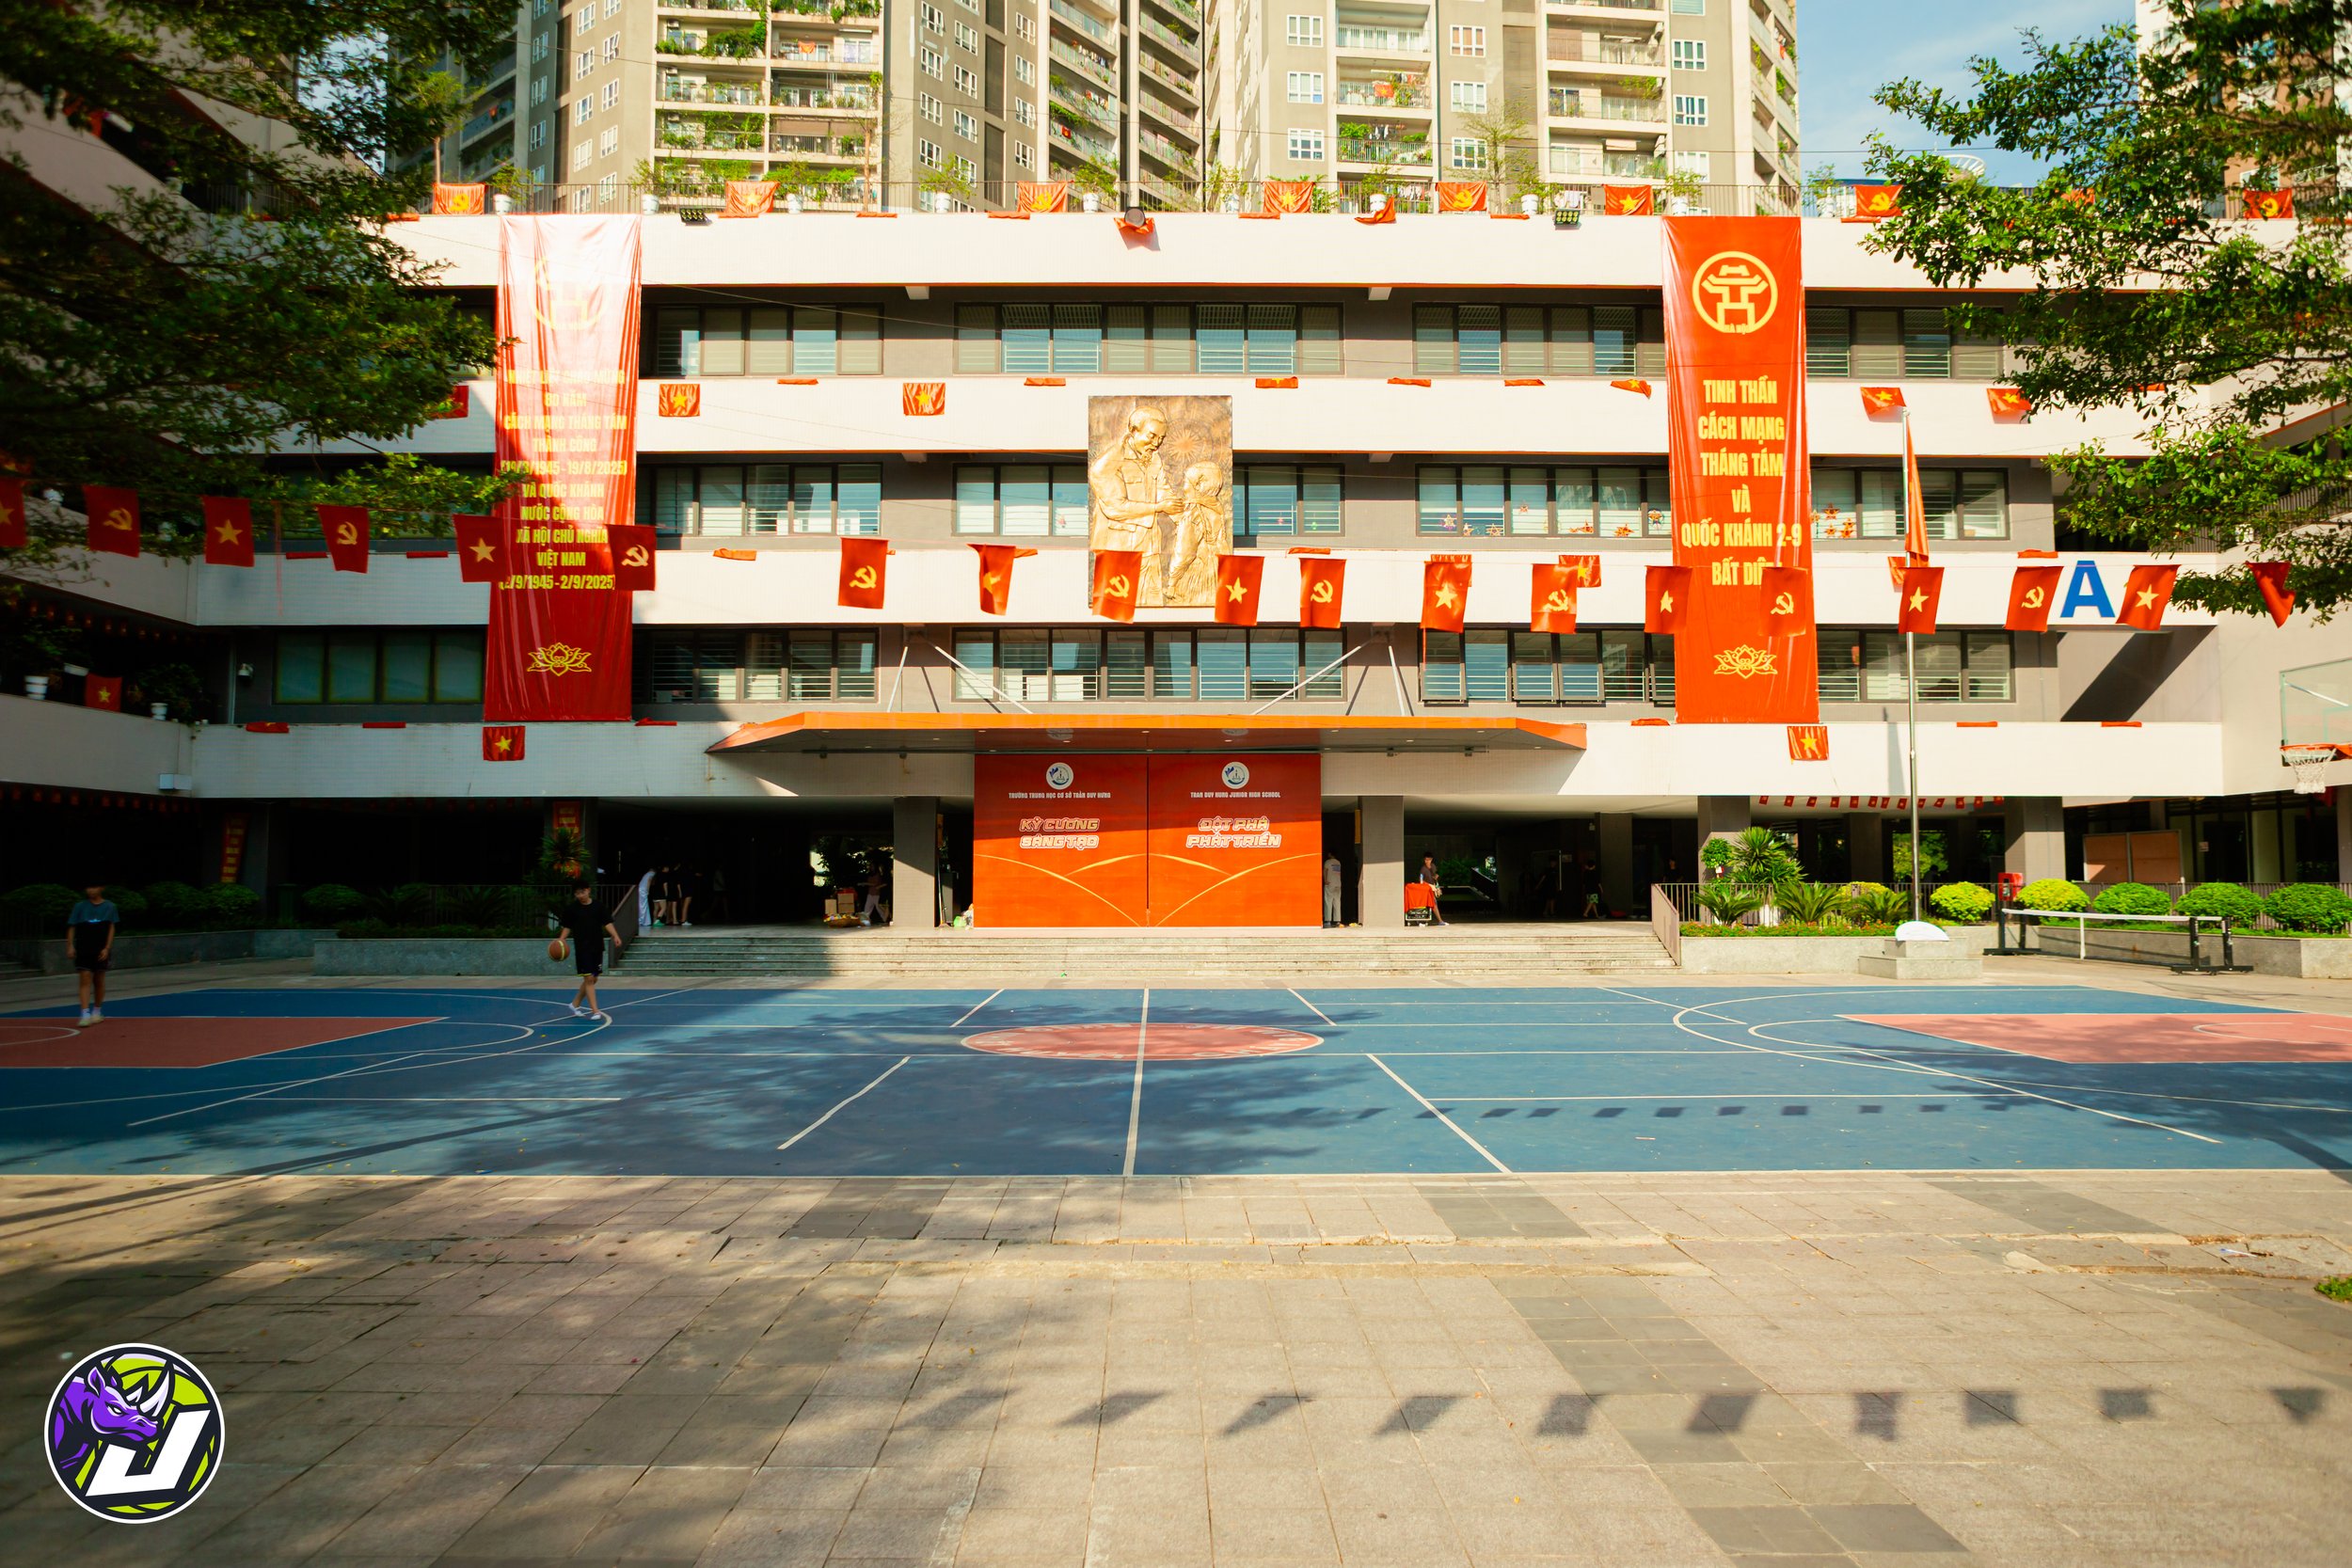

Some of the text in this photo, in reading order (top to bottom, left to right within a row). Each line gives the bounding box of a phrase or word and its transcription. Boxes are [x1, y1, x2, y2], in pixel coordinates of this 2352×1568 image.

[545, 389, 587, 406] 80 NĂM
[1703, 375, 1778, 404] TINH THẦN
[503, 412, 627, 432] CÁCH MẠNG THÁNG TÁM
[1698, 410, 1785, 445] CÁCH MẠNG
[532, 435, 597, 452] THÀNH CÔNG
[1700, 447, 1784, 477] THÁNG TÁM
[539, 481, 567, 499] QUỐC
[570, 481, 604, 498] KHÁNH
[1731, 483, 1751, 513] VÀ
[520, 503, 604, 523] NƯỚC CỘNG HÒA
[516, 524, 608, 546] XÃ HỘI CHỦ NGHĨA
[1681, 517, 1803, 548] QUỐC KHÁNH 2-9
[536, 548, 586, 568] VIỆT NAM
[1712, 557, 1783, 585] BẤT DI
[2059, 560, 2116, 618] A
[1199, 816, 1232, 833] ĐỘT
[1020, 833, 1099, 850] SÁNG TẠO
[1186, 833, 1232, 847] PHÁT
